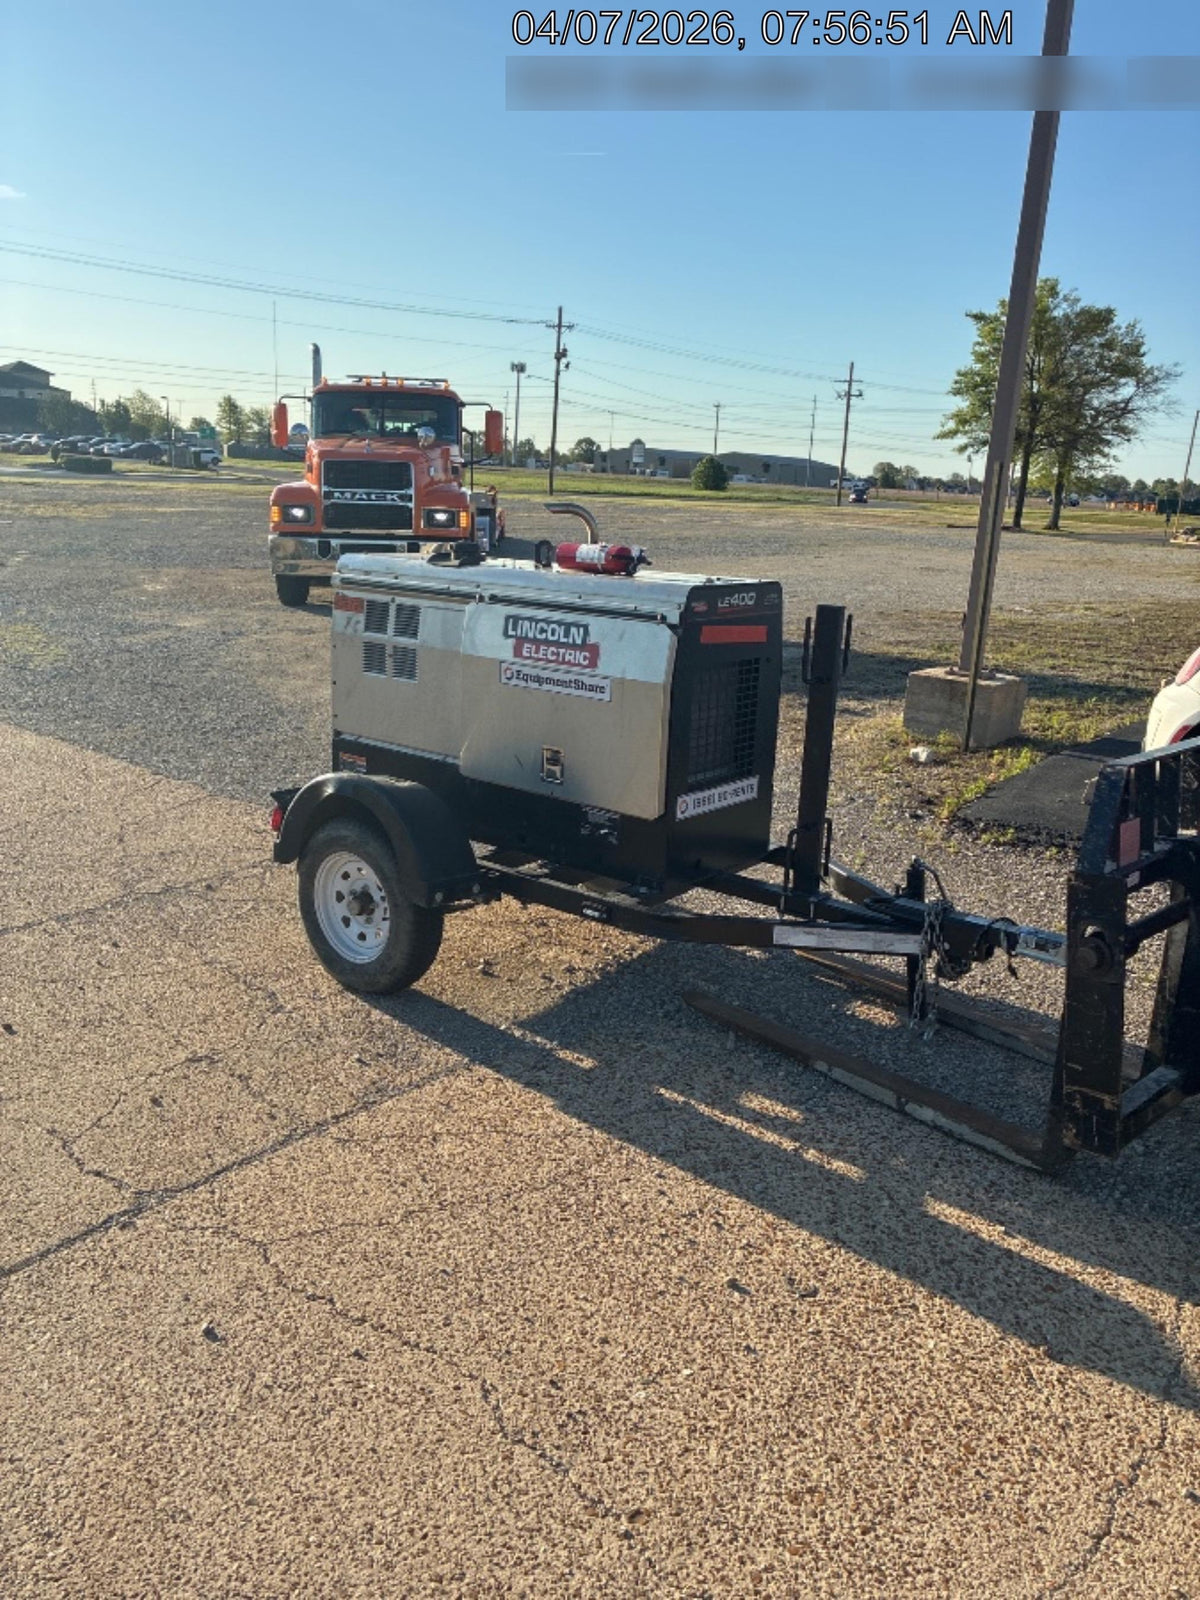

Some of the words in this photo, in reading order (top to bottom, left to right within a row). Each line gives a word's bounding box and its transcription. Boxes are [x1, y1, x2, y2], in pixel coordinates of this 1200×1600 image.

[333, 491, 401, 502] MACK
[507, 618, 584, 645] LINCOLN
[522, 642, 590, 665] ELECTRIC
